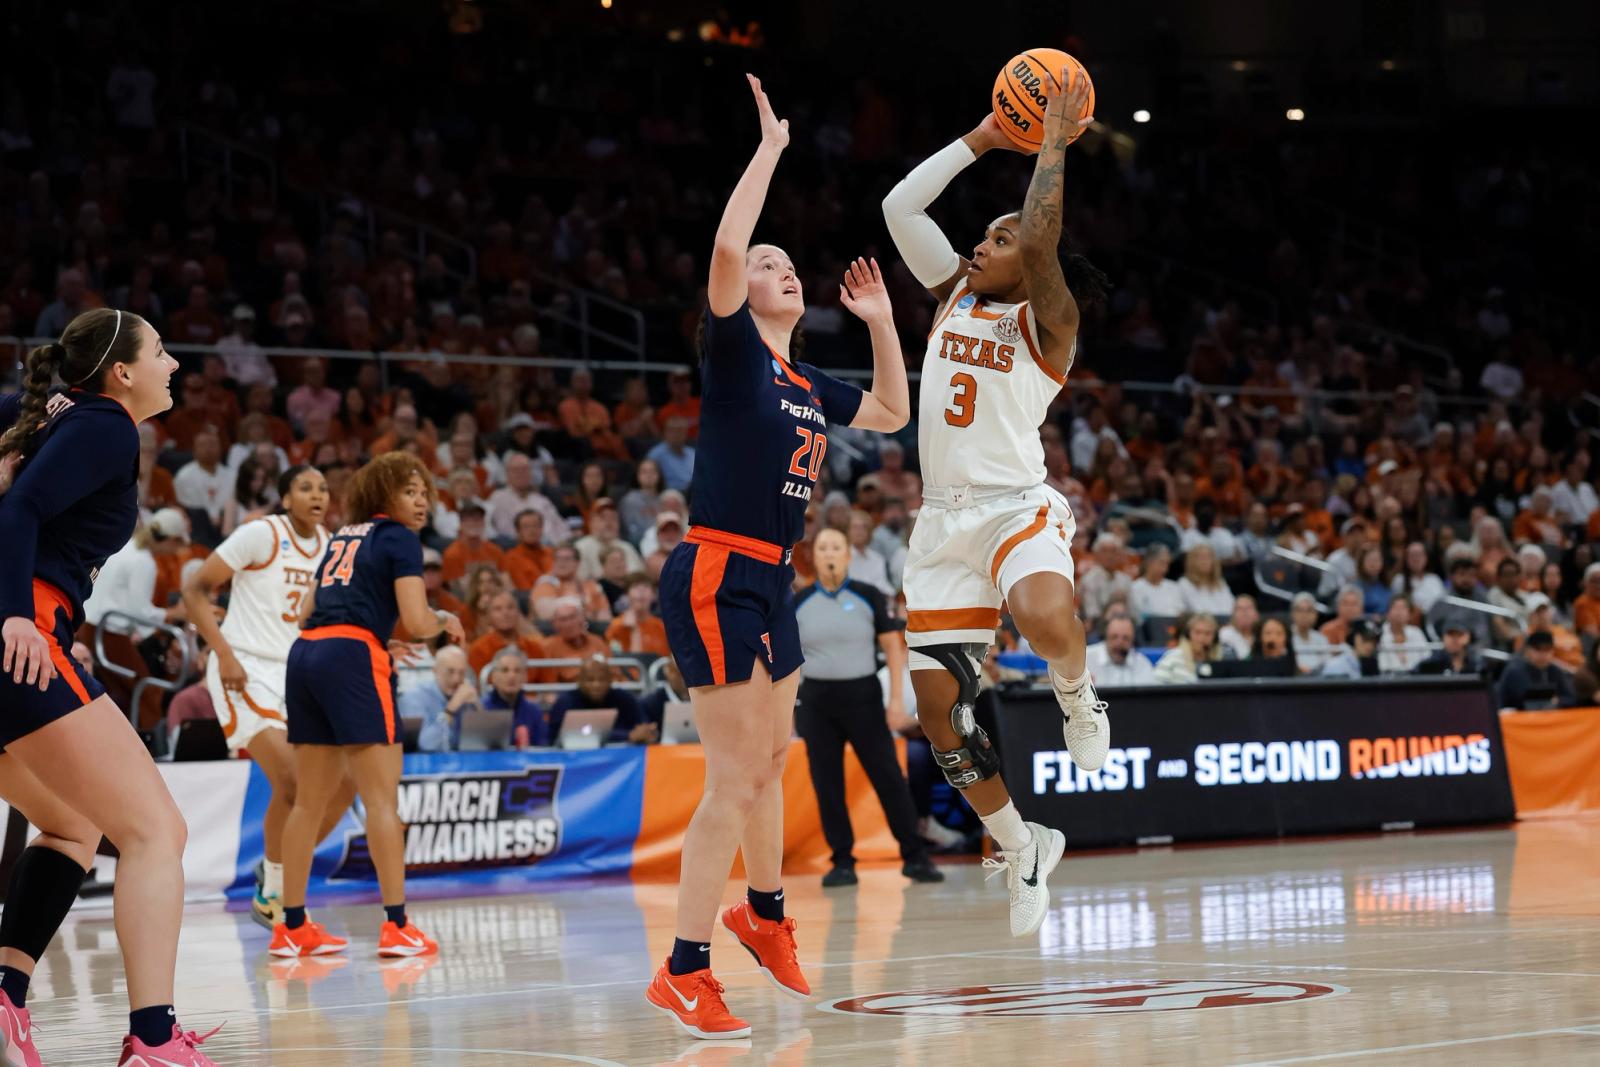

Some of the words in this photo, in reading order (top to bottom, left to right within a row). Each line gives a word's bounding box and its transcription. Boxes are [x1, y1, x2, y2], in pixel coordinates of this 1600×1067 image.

[1012, 60, 1049, 112] Wilso
[996, 89, 1031, 133] NCAA
[998, 318, 1018, 337] SEC
[939, 330, 1015, 373] TEXAS
[780, 399, 827, 429] FIGHTIN
[944, 372, 977, 428] 3
[788, 426, 827, 482] 20
[781, 481, 812, 502] ILLIN
[283, 566, 313, 587] TEX
[321, 539, 361, 587] 24
[281, 591, 302, 622] 3
[1157, 759, 1188, 778] AND
[1194, 739, 1341, 787] SECOND
[1349, 734, 1491, 780] ROUNDS
[397, 780, 501, 824] MARCH
[405, 818, 558, 865] MADNESS
